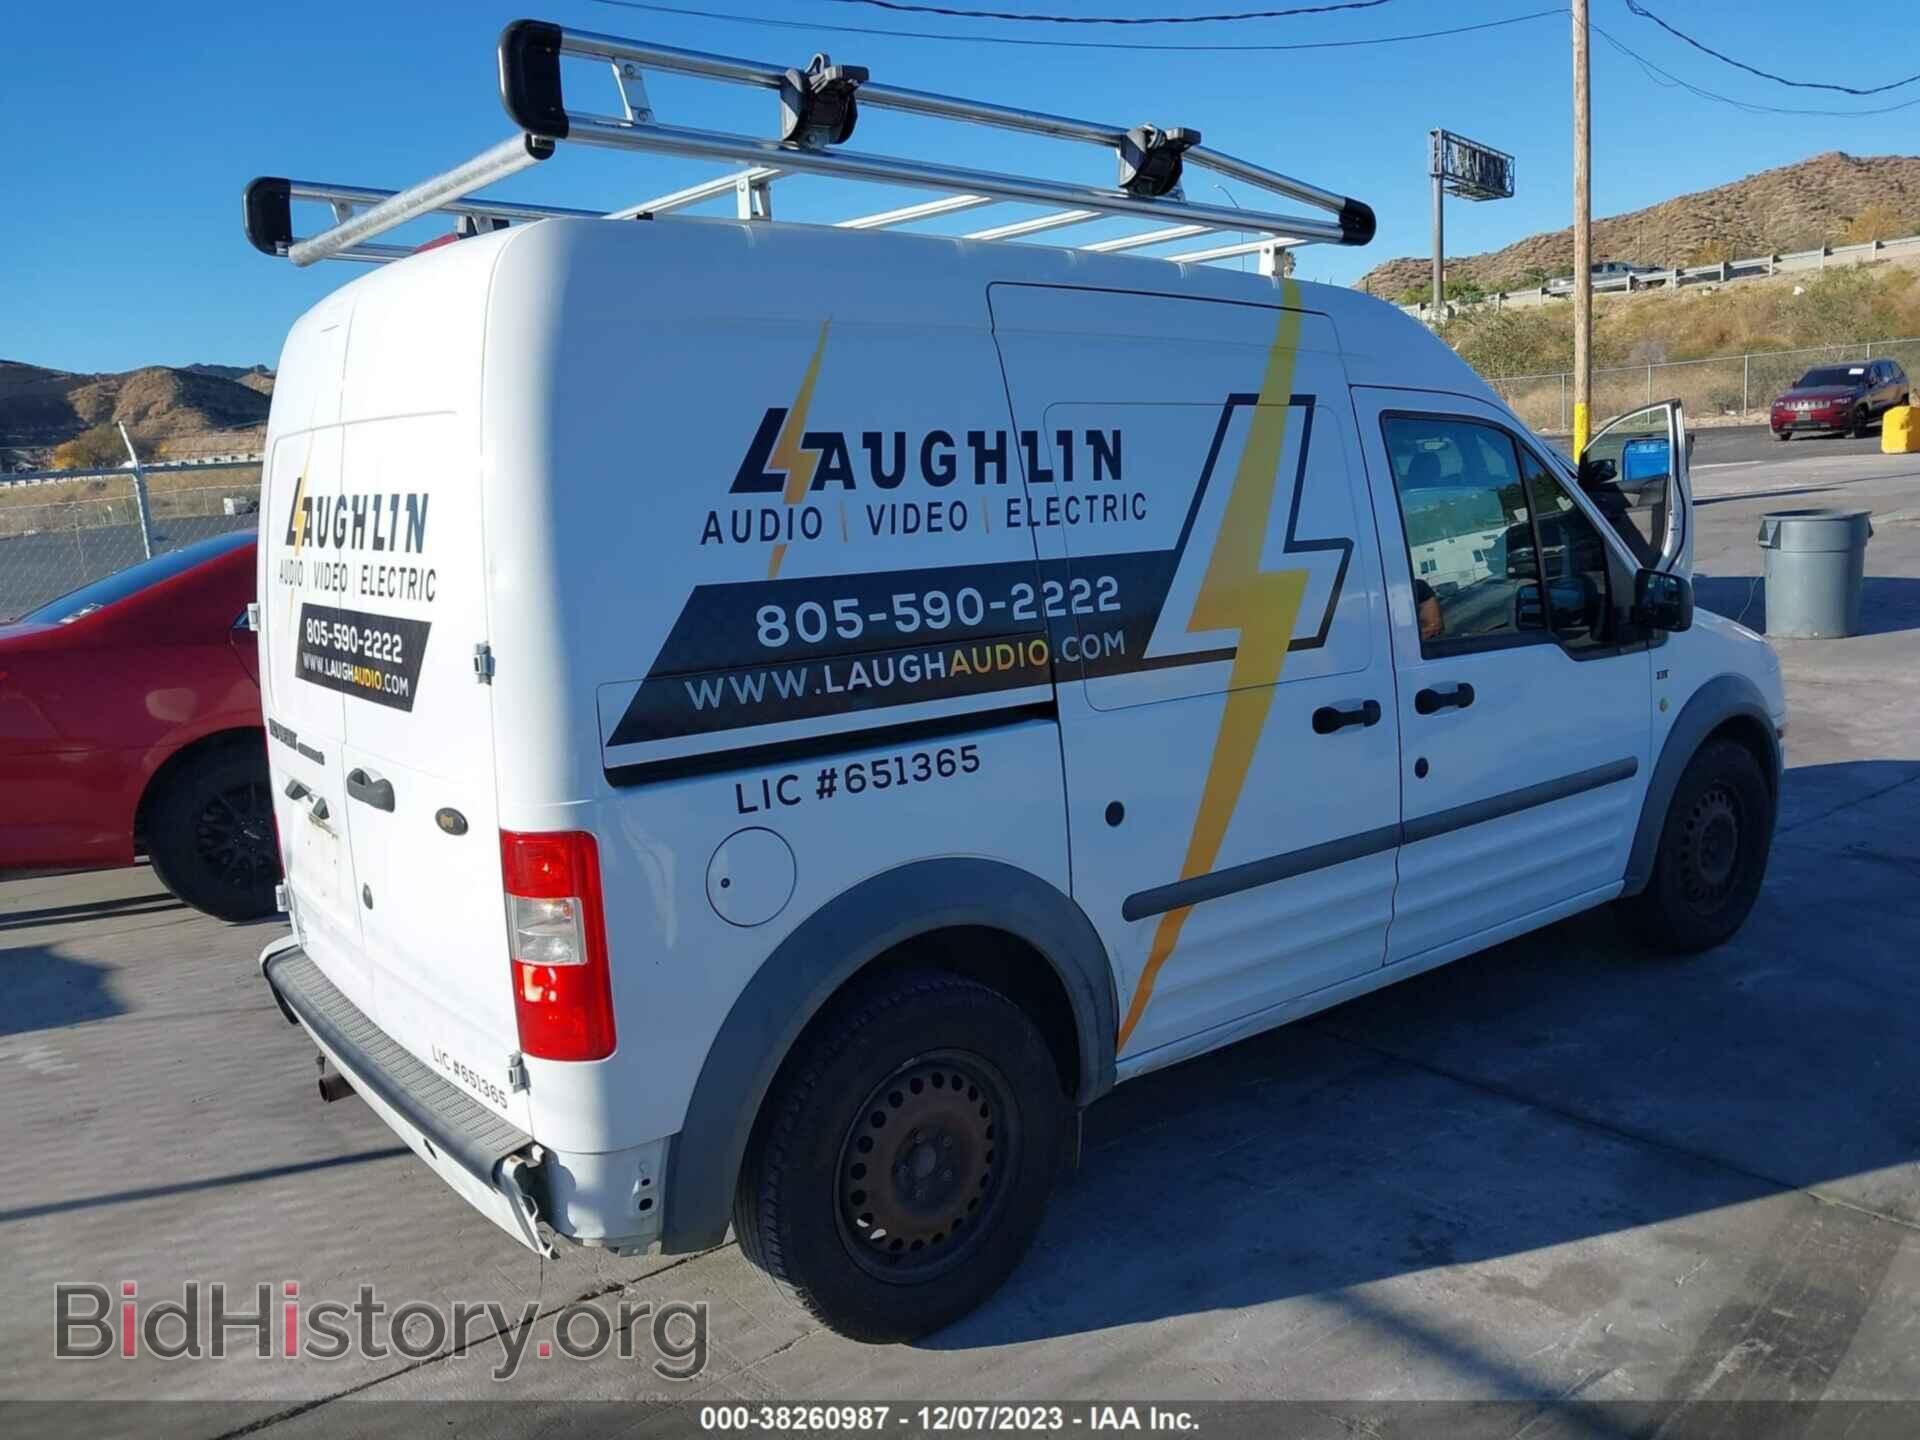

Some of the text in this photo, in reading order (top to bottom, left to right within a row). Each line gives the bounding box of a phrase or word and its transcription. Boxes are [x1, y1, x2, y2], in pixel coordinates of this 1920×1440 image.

[729, 407, 1122, 494] LAUGHLIN
[285, 476, 429, 554] LAUGHLIN
[700, 491, 1148, 546] AUDIO VIDEO ELECTRIC
[279, 559, 437, 602] AUDIO VIDEO ELECTRIC
[755, 575, 1122, 649] 805-590-2222
[301, 651, 410, 698] WWW.LAUGHAUDIO.COM
[305, 617, 404, 664] 805-590-2222
[685, 630, 1127, 712] WWW.LAUGHAUDIO.COM
[735, 744, 981, 815] LIC #651365
[431, 1043, 508, 1110] LIC #651365
